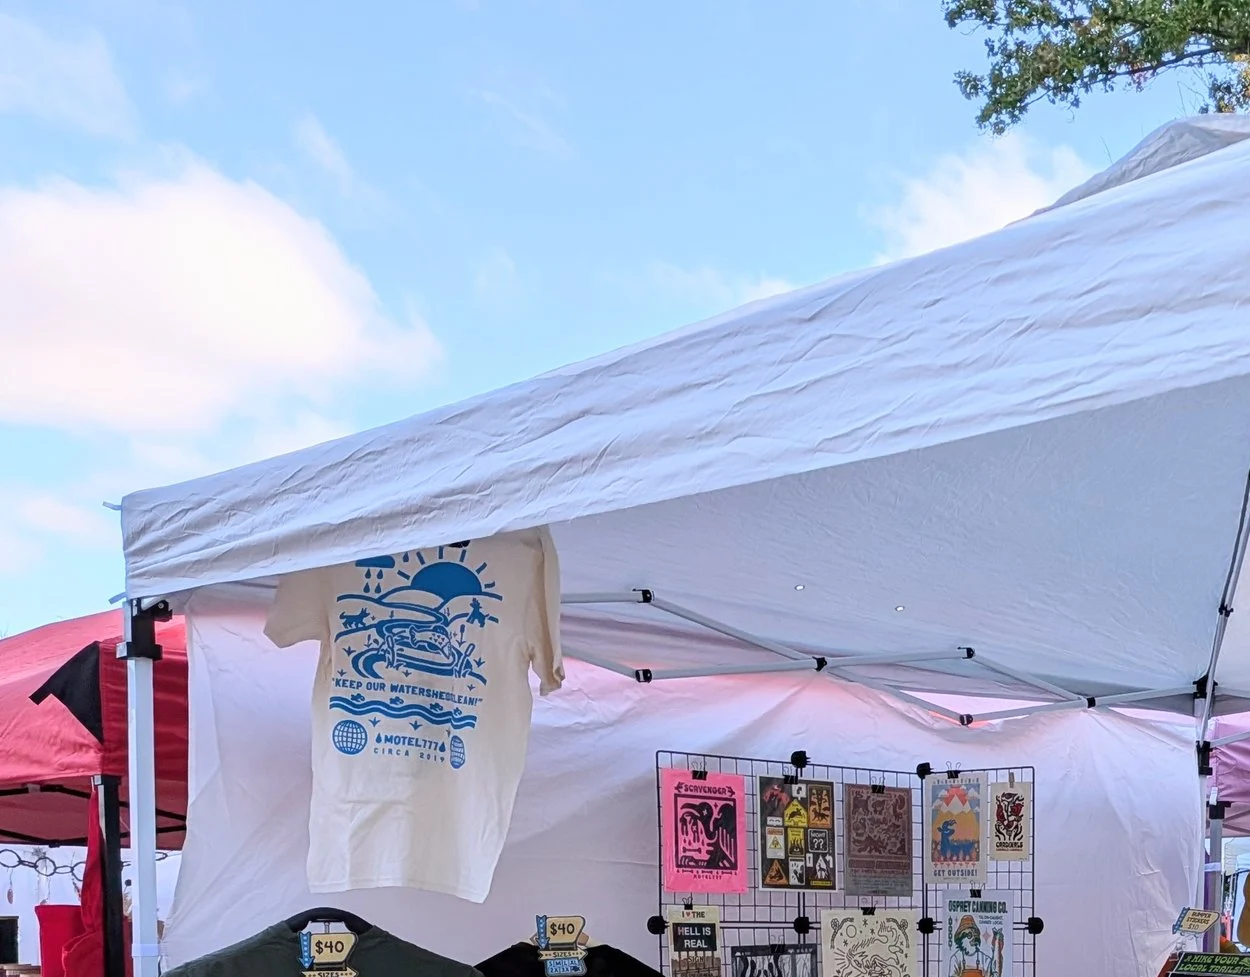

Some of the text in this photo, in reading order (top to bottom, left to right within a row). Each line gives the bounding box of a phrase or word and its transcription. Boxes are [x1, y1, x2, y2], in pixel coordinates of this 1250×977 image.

[366, 682, 386, 692] OUR
[384, 735, 438, 750] MOTEL777
[374, 747, 445, 763] CIRCA 2019
[684, 784, 727, 796] SCAVENGER
[933, 869, 946, 877] GET
[550, 922, 575, 936] $40
[677, 927, 711, 936] HELL IS
[315, 940, 345, 955] $40
[684, 940, 708, 948] REAL
[1215, 956, 1239, 964] YOUR
[1178, 963, 1207, 972] LOCAL
